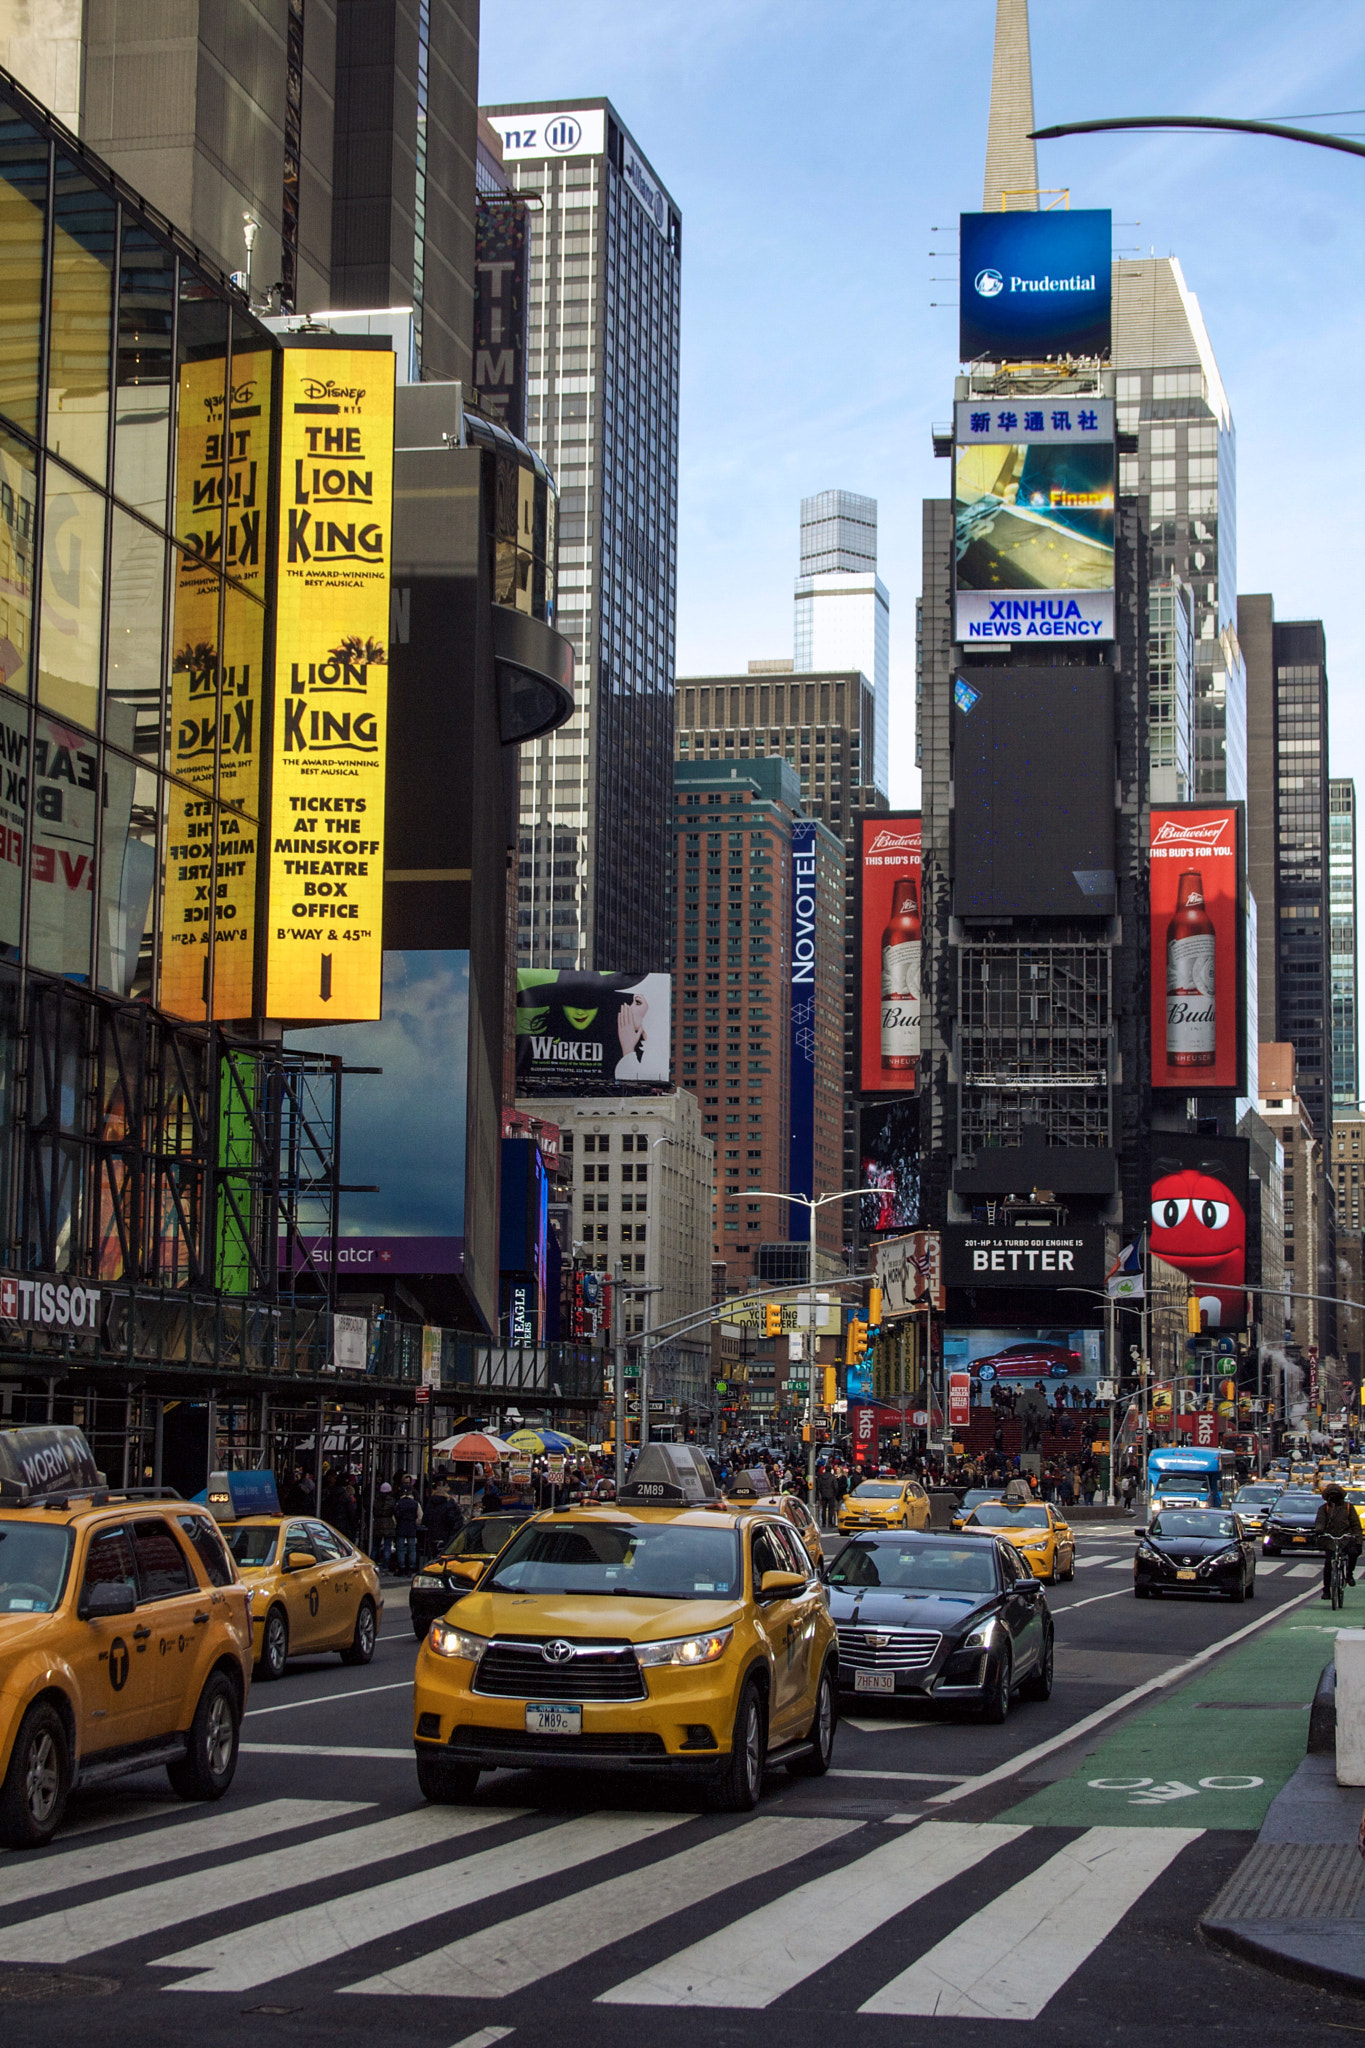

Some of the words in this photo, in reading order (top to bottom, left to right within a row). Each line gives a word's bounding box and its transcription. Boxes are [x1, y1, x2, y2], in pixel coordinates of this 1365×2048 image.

[1009, 274, 1096, 293] Prudential
[970, 410, 1098, 432] 新华通讯社
[305, 426, 361, 452] THE
[306, 570, 385, 579] AWARD-WINNING
[326, 580, 365, 588] MUSICAL
[989, 600, 1082, 620] XINHUA
[969, 622, 1022, 636] NEWS
[1026, 621, 1103, 635] AGENCY
[301, 759, 380, 768] AWARD-WINNING
[289, 797, 367, 812] TICKETS
[293, 818, 318, 832] AT
[325, 819, 360, 833] THE
[1159, 827, 1220, 839] Budweiser
[274, 839, 380, 855] MINSKOFF
[1149, 848, 1167, 857] THIS
[1169, 848, 1194, 857] BUD'S
[1195, 847, 1212, 856] FOR
[1213, 846, 1233, 855] YOU.
[284, 860, 368, 876] THEATRE
[865, 856, 883, 866] THIS
[884, 856, 906, 866] BUD'S
[304, 882, 348, 897] BOX
[292, 903, 359, 918] OFFICE
[791, 840, 816, 983] NOVOTEL
[277, 928, 323, 940] B'WAY
[327, 929, 338, 940] &
[342, 930, 371, 941] 45TH
[973, 1250, 1074, 1271] BETTER
[19, 1280, 100, 1327] TISSOT
[515, 1288, 526, 1332] EAGLE
[859, 1408, 875, 1439] tkts
[1198, 1414, 1214, 1445] tkts
[22, 1435, 88, 1488] MORMN
[637, 1484, 664, 1495] 2M89
[857, 1676, 880, 1687] 7HFN
[881, 1677, 893, 1688] 30
